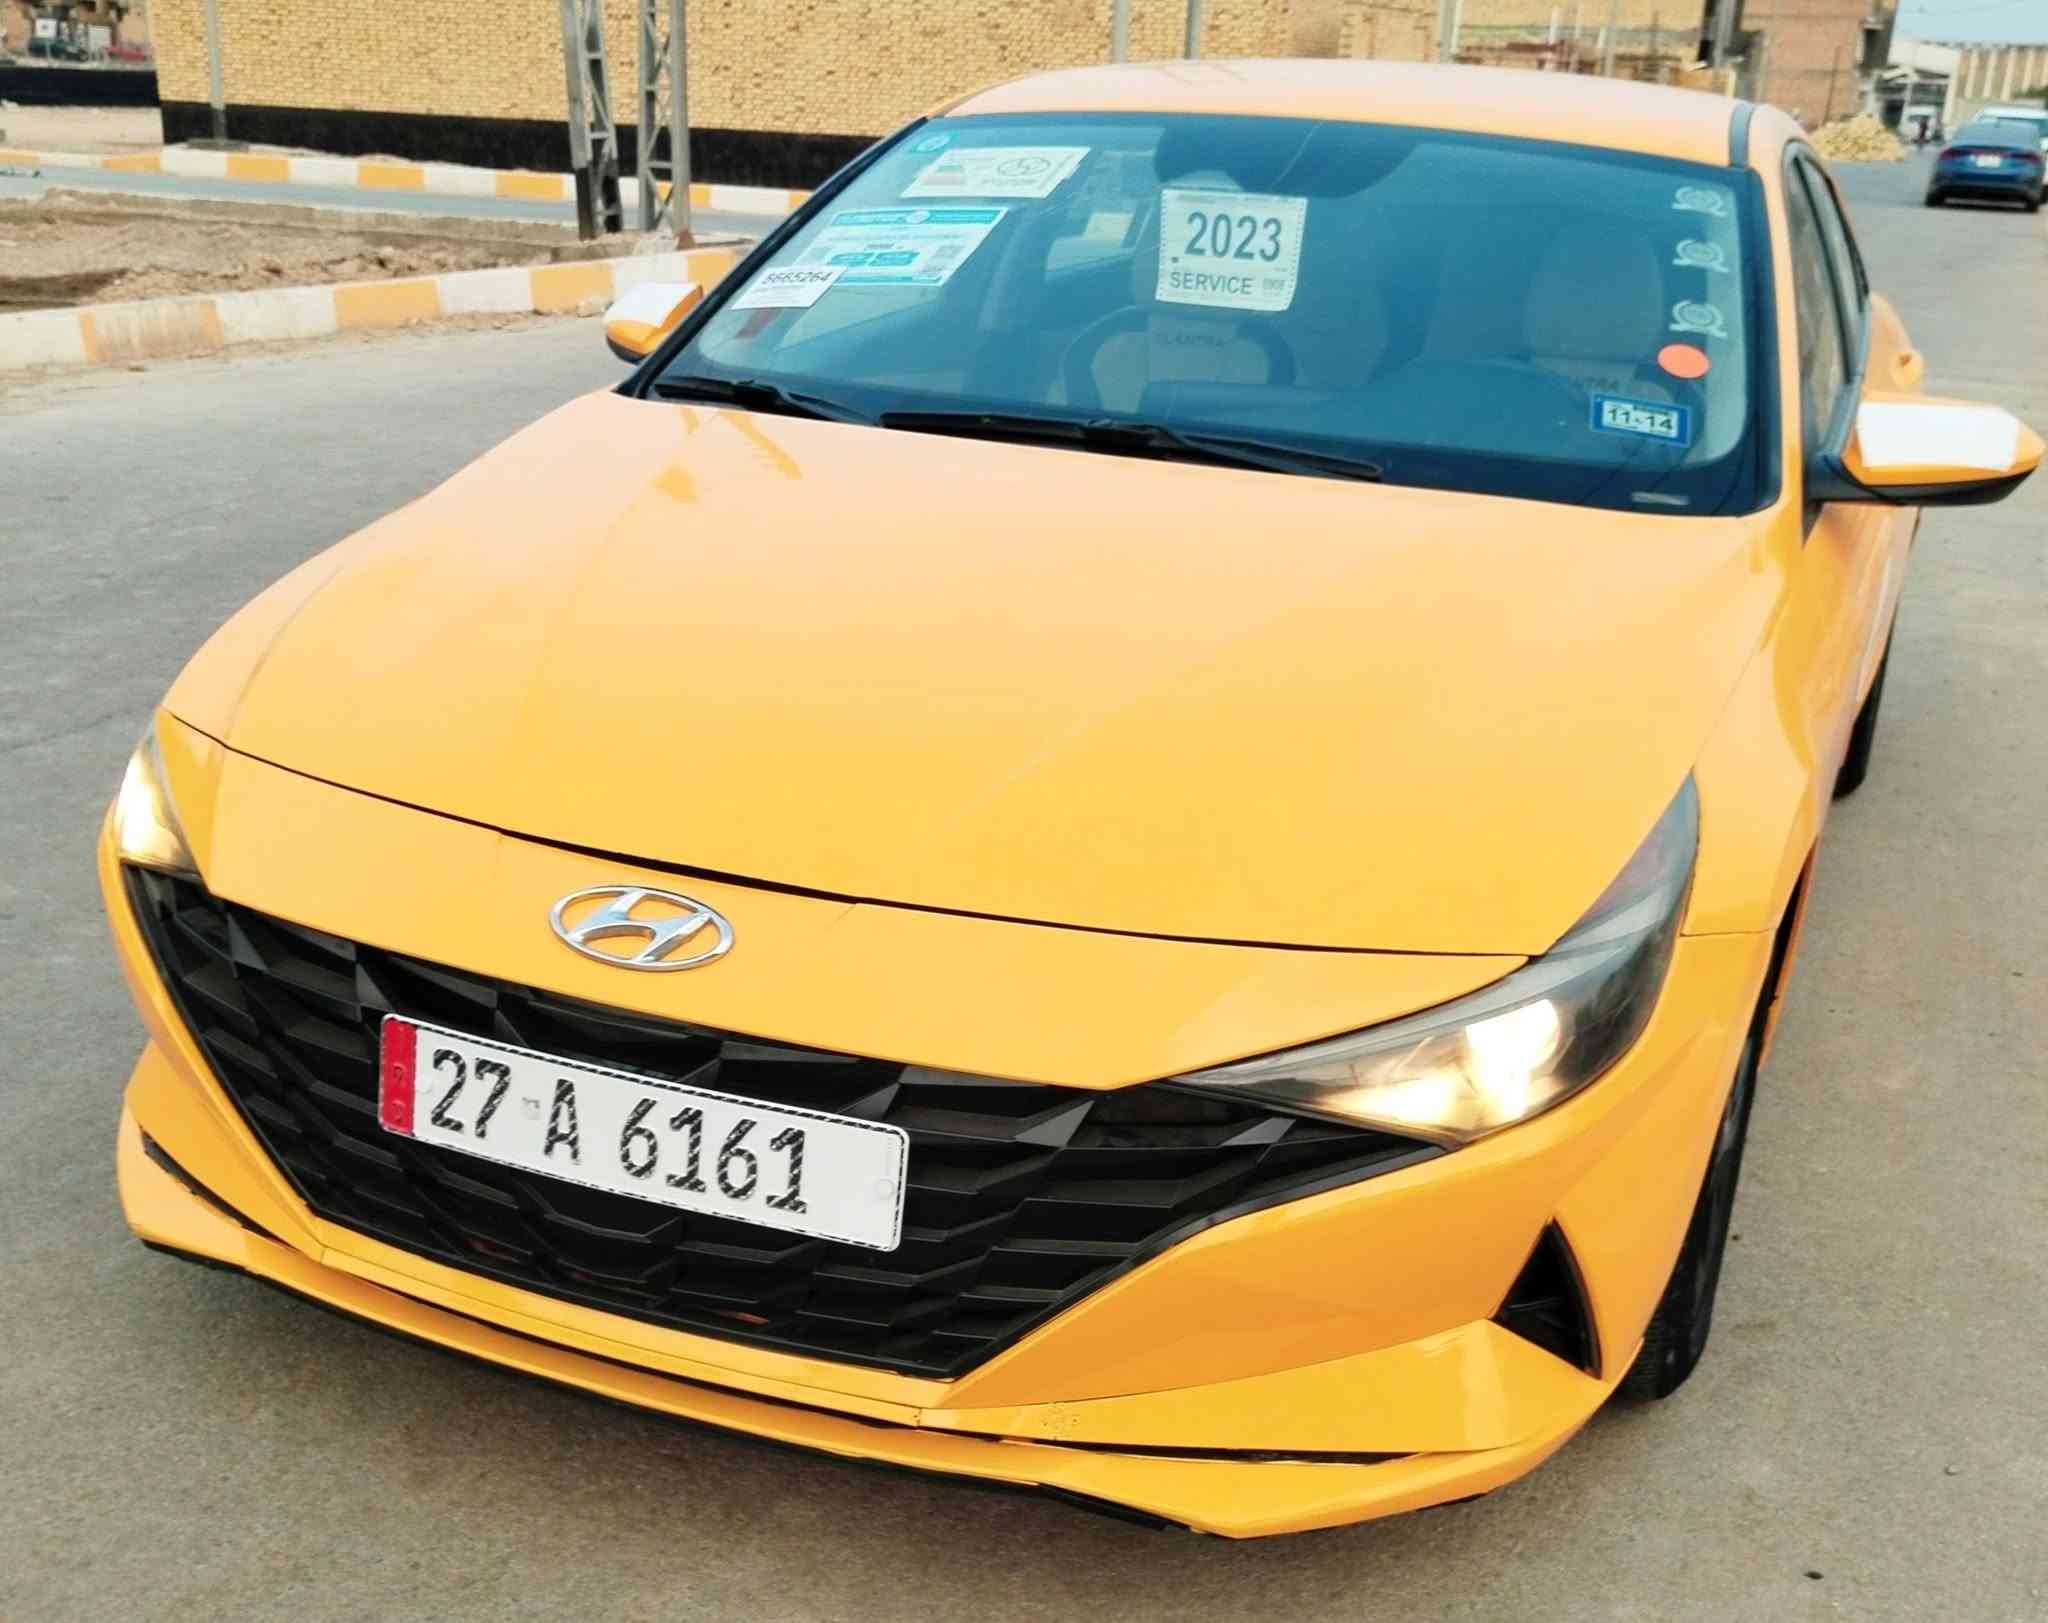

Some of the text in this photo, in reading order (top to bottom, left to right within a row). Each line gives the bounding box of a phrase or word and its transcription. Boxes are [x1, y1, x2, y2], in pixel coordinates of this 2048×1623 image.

[1184, 211, 1283, 262] 2023
[1169, 271, 1255, 295] SERVICE
[431, 1048, 511, 1139] 27
[544, 1079, 581, 1164] A
[619, 1097, 808, 1214] 6161
